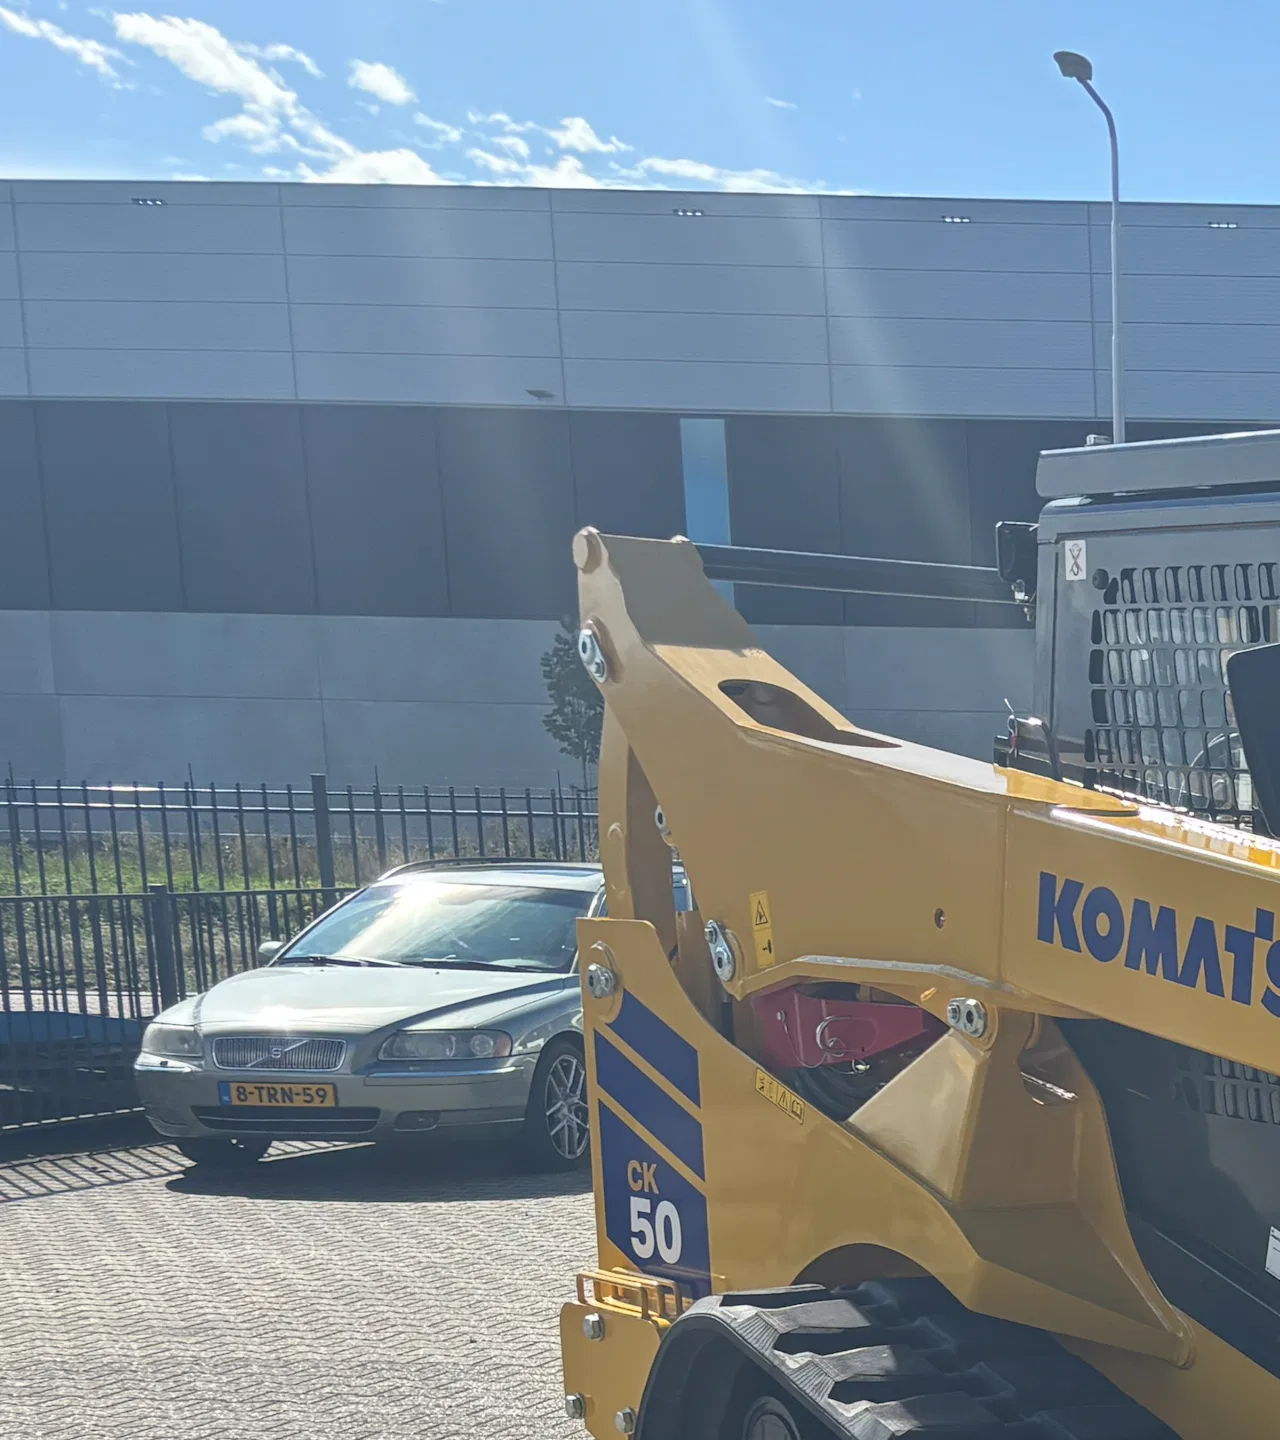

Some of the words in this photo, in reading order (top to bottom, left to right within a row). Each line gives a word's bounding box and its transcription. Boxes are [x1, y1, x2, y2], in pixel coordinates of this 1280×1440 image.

[236, 1085, 327, 1104] 8-TRN-59
[627, 1160, 659, 1194] CK
[630, 1196, 682, 1264] 50
